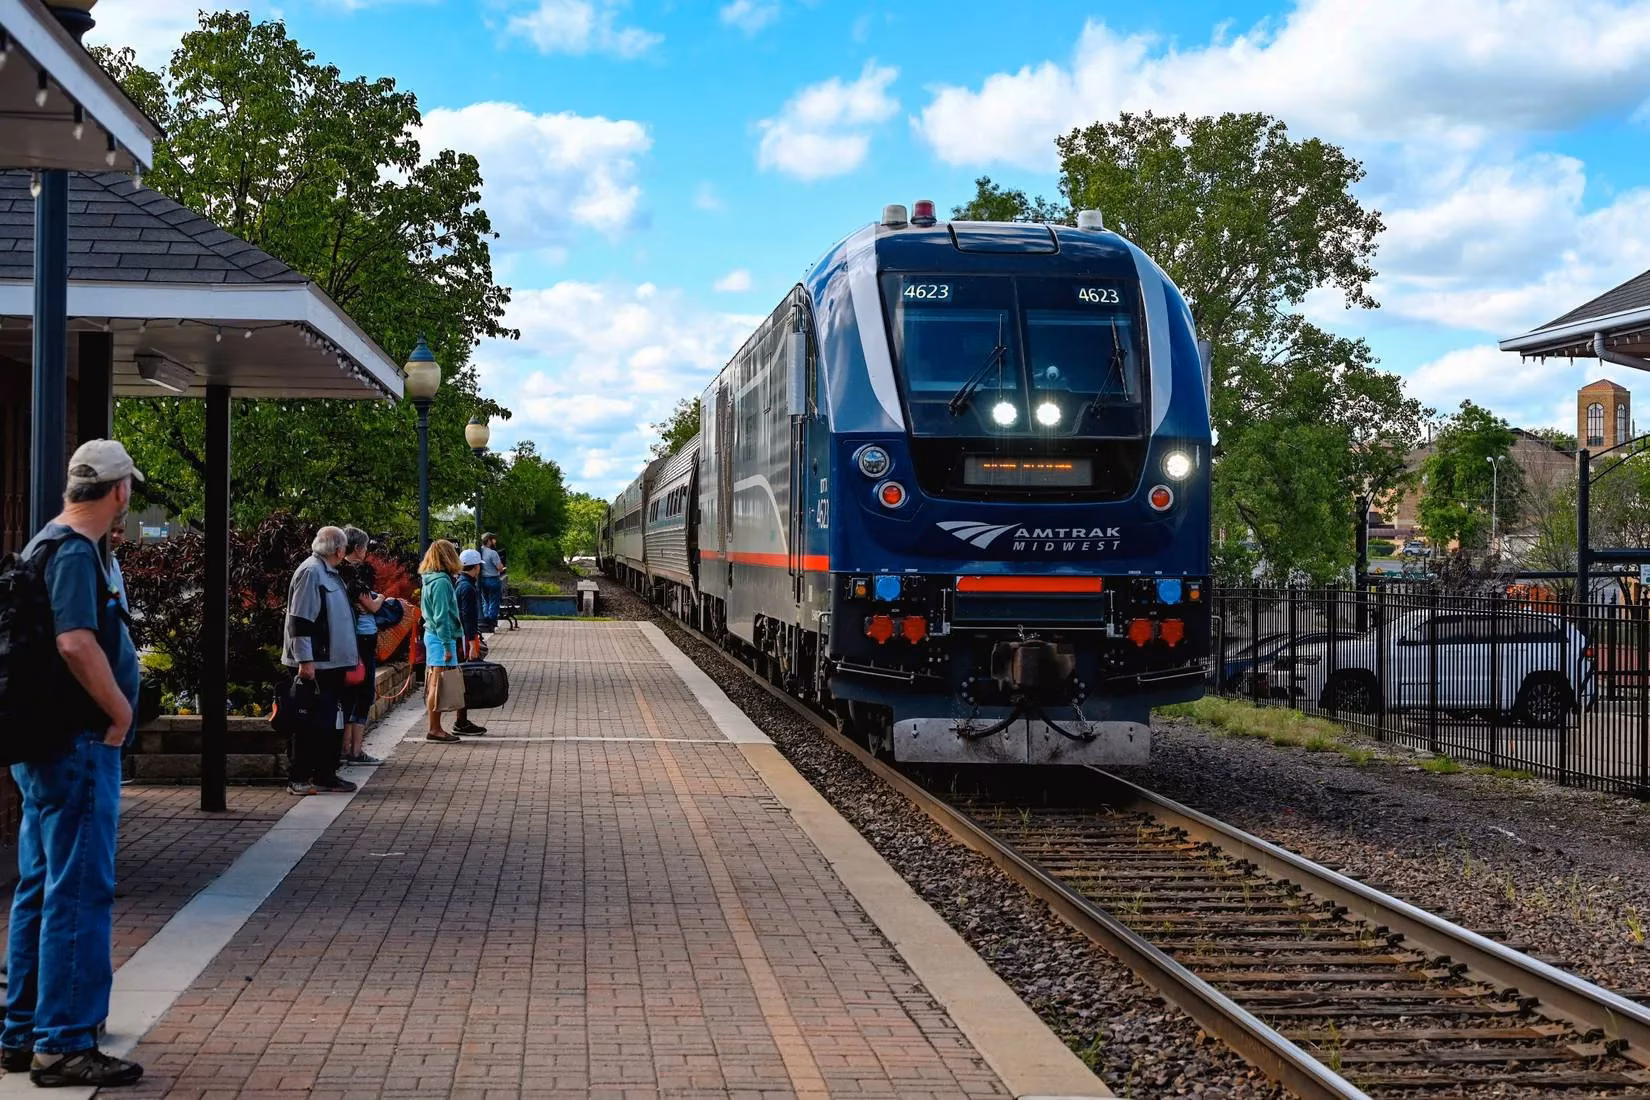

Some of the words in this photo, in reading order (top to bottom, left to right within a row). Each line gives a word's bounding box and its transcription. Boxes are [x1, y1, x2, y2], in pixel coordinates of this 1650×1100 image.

[903, 284, 949, 299] 4623
[1078, 287, 1120, 303] 4623
[1014, 527, 1121, 538] AMTRAK
[1013, 541, 1121, 551] MIDWEST
